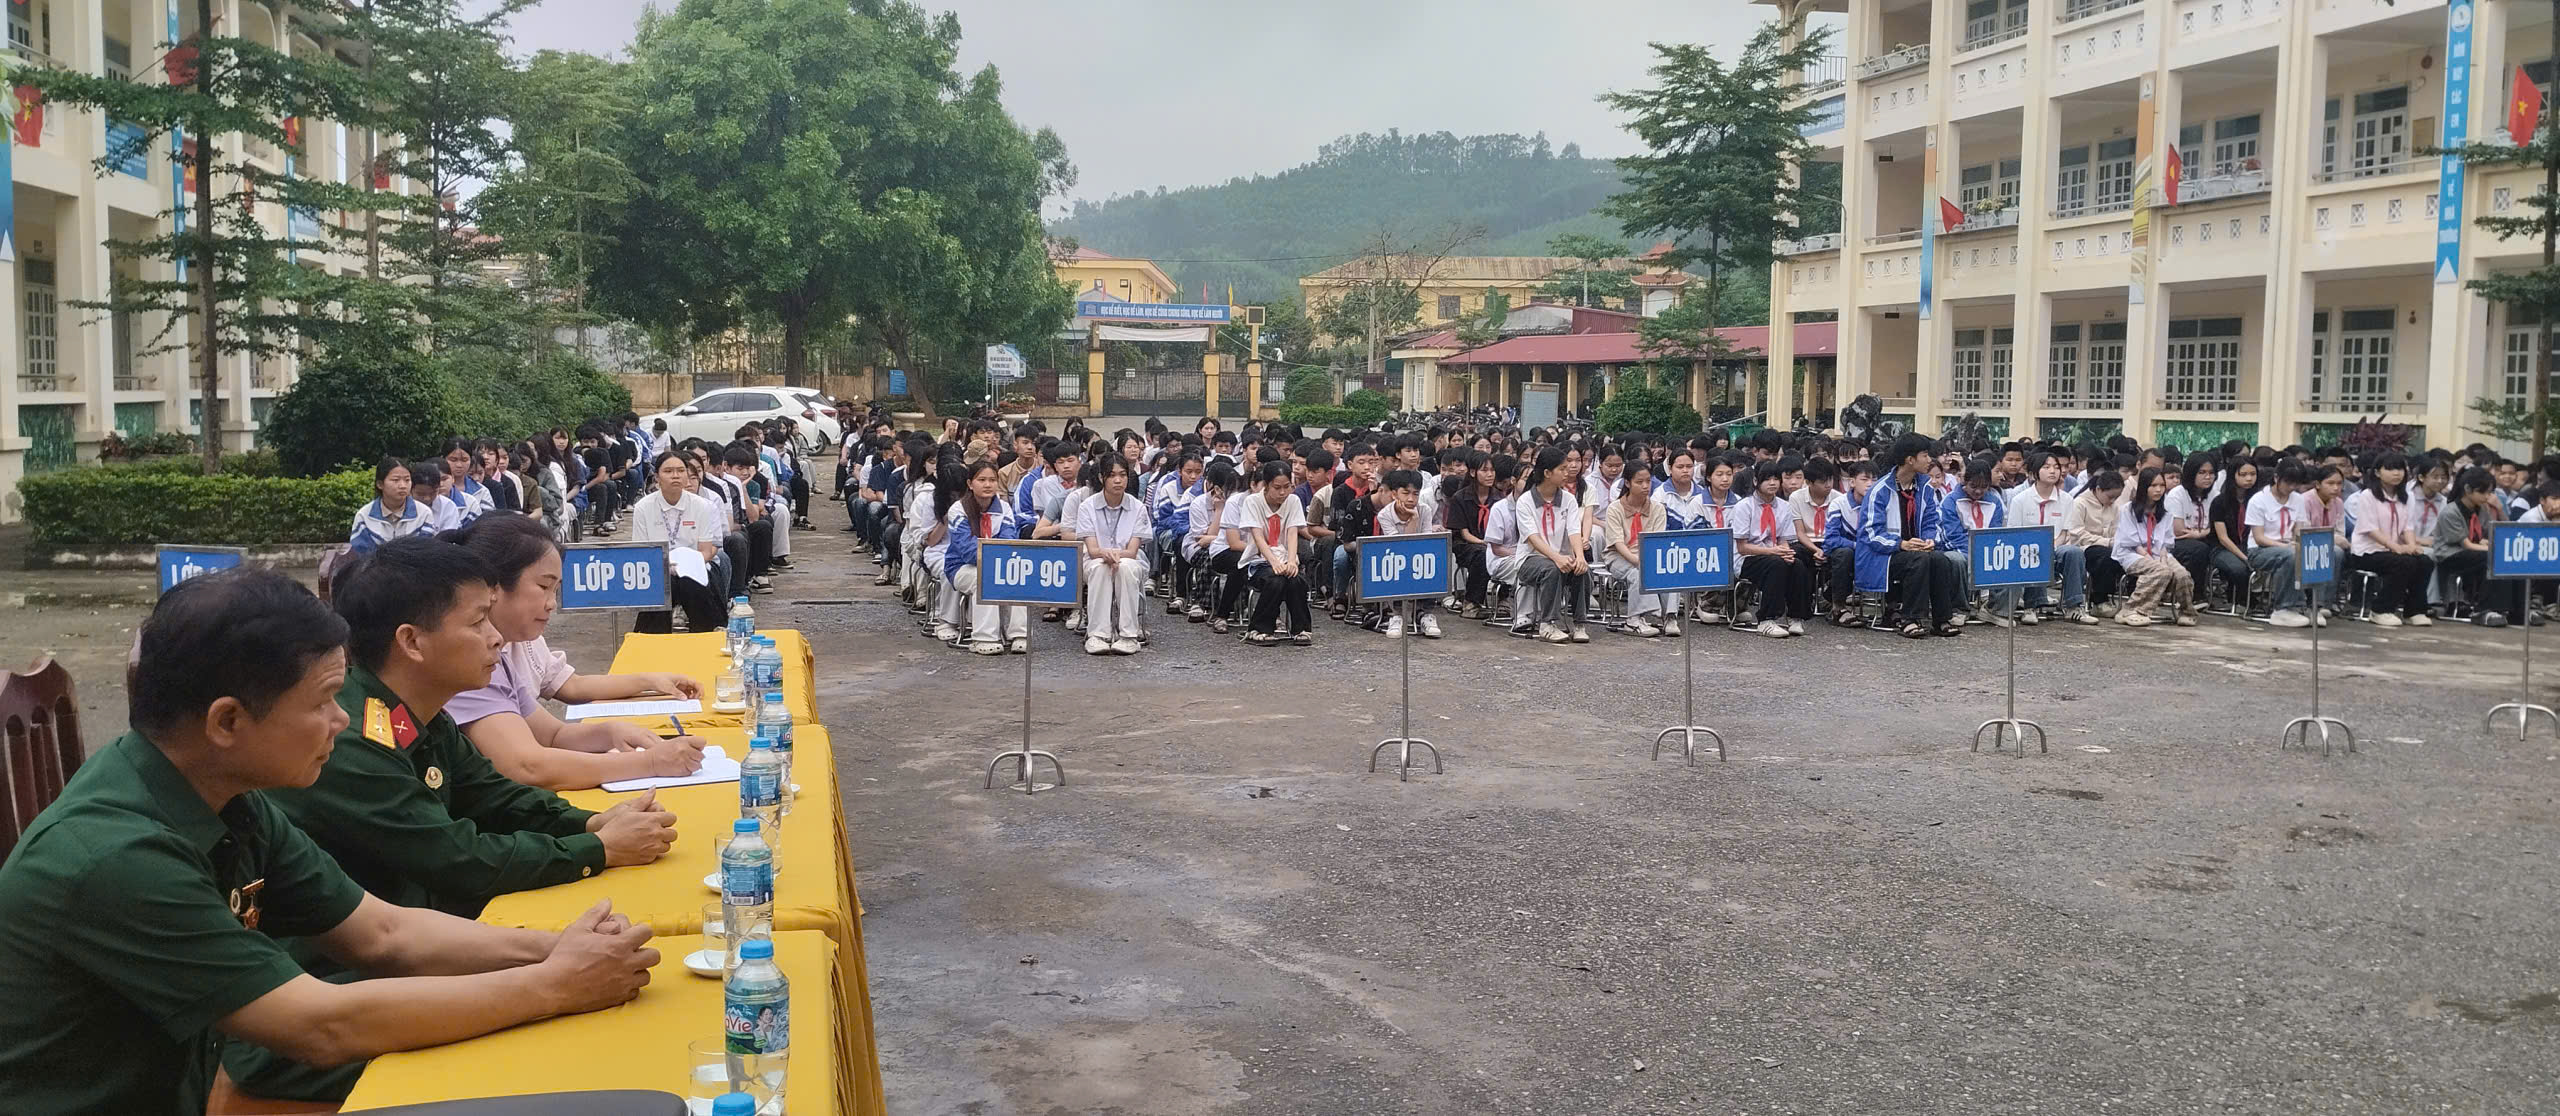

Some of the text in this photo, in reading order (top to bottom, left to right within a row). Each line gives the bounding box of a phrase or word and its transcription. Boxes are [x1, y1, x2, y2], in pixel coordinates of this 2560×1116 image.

[1656, 541, 1720, 574] LỚP 8A
[1984, 539, 2040, 571] LỚP 8B
[2304, 540, 2319, 571] LỚP
[2502, 532, 2559, 562] LỚP 8D
[573, 555, 651, 592] LỚP 9B
[994, 551, 1067, 588] LỚP 9C
[1371, 548, 1436, 582] LỚP 9D
